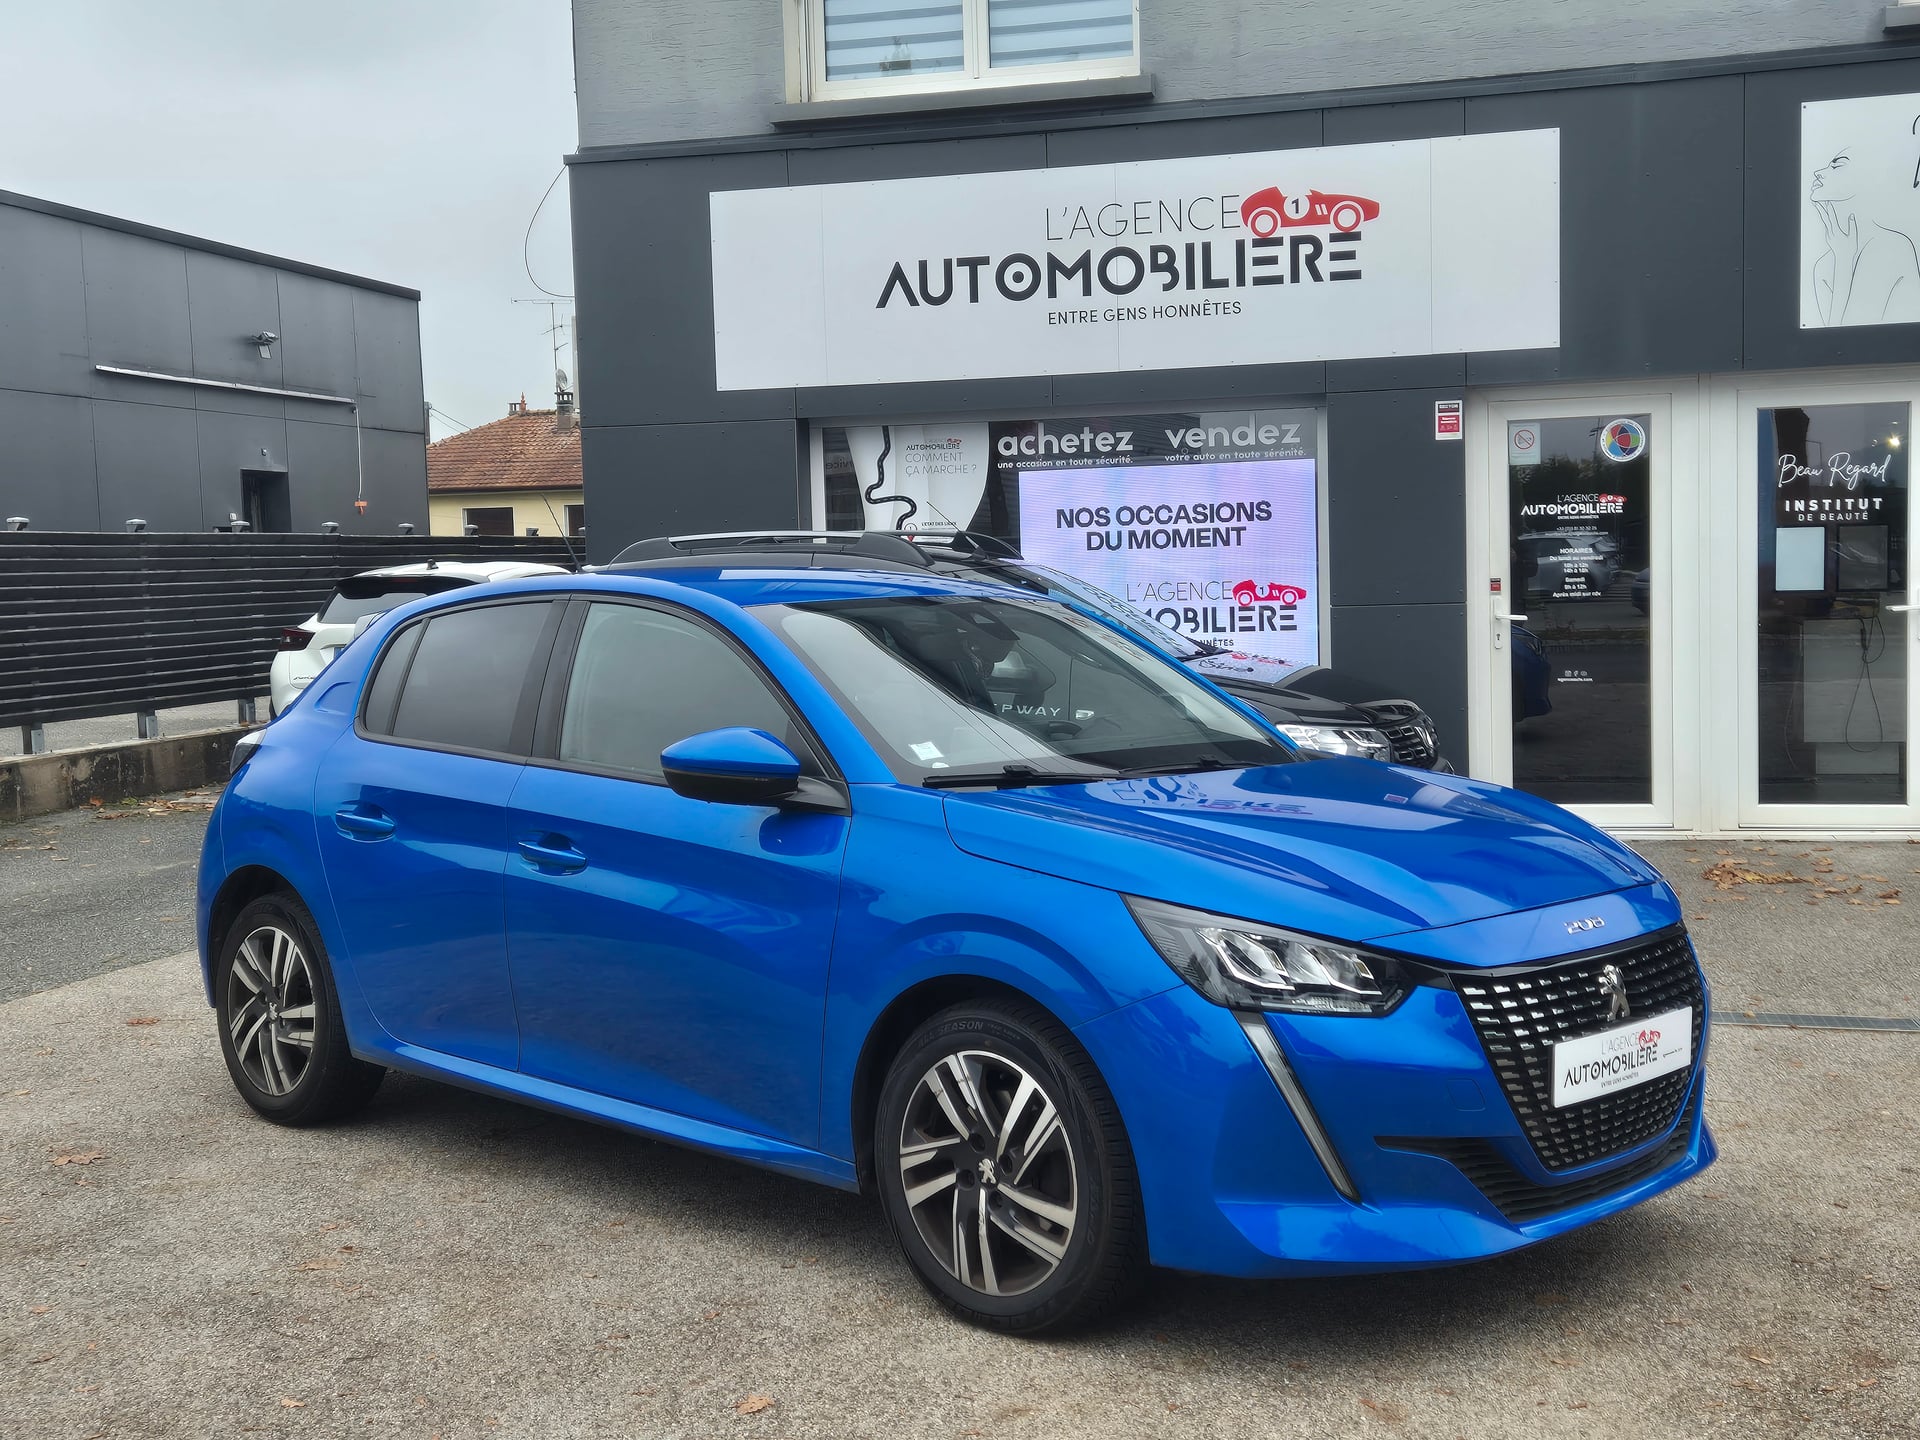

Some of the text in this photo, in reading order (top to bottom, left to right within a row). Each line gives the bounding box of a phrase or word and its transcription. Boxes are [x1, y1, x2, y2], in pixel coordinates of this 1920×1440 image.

[1046, 194, 1241, 240] L'AGENCE
[1048, 299, 1242, 325] ENTRE GENS HONNÊTES
[997, 422, 1301, 456] achetez vendez
[905, 451, 963, 463] COMMENT
[997, 461, 1014, 469] une
[1016, 459, 1053, 468] occasion
[1069, 458, 1093, 466] toute
[1164, 454, 1190, 462] votre
[1193, 453, 1216, 461] auto
[1234, 451, 1261, 459] toute
[905, 465, 920, 477] ÇA
[922, 463, 969, 474] MARCHE
[1778, 452, 1892, 490] Beau Regard
[1557, 493, 1599, 502] L'AGENCE
[1785, 498, 1883, 511] INSTITUT
[1056, 500, 1272, 528] NOS OCCASIONS
[1798, 511, 1869, 521] DE BEAUTÉ
[1086, 526, 1247, 551] DU MOMENT
[1126, 580, 1233, 602] L'AGENCE
[1564, 916, 1606, 935] 208
